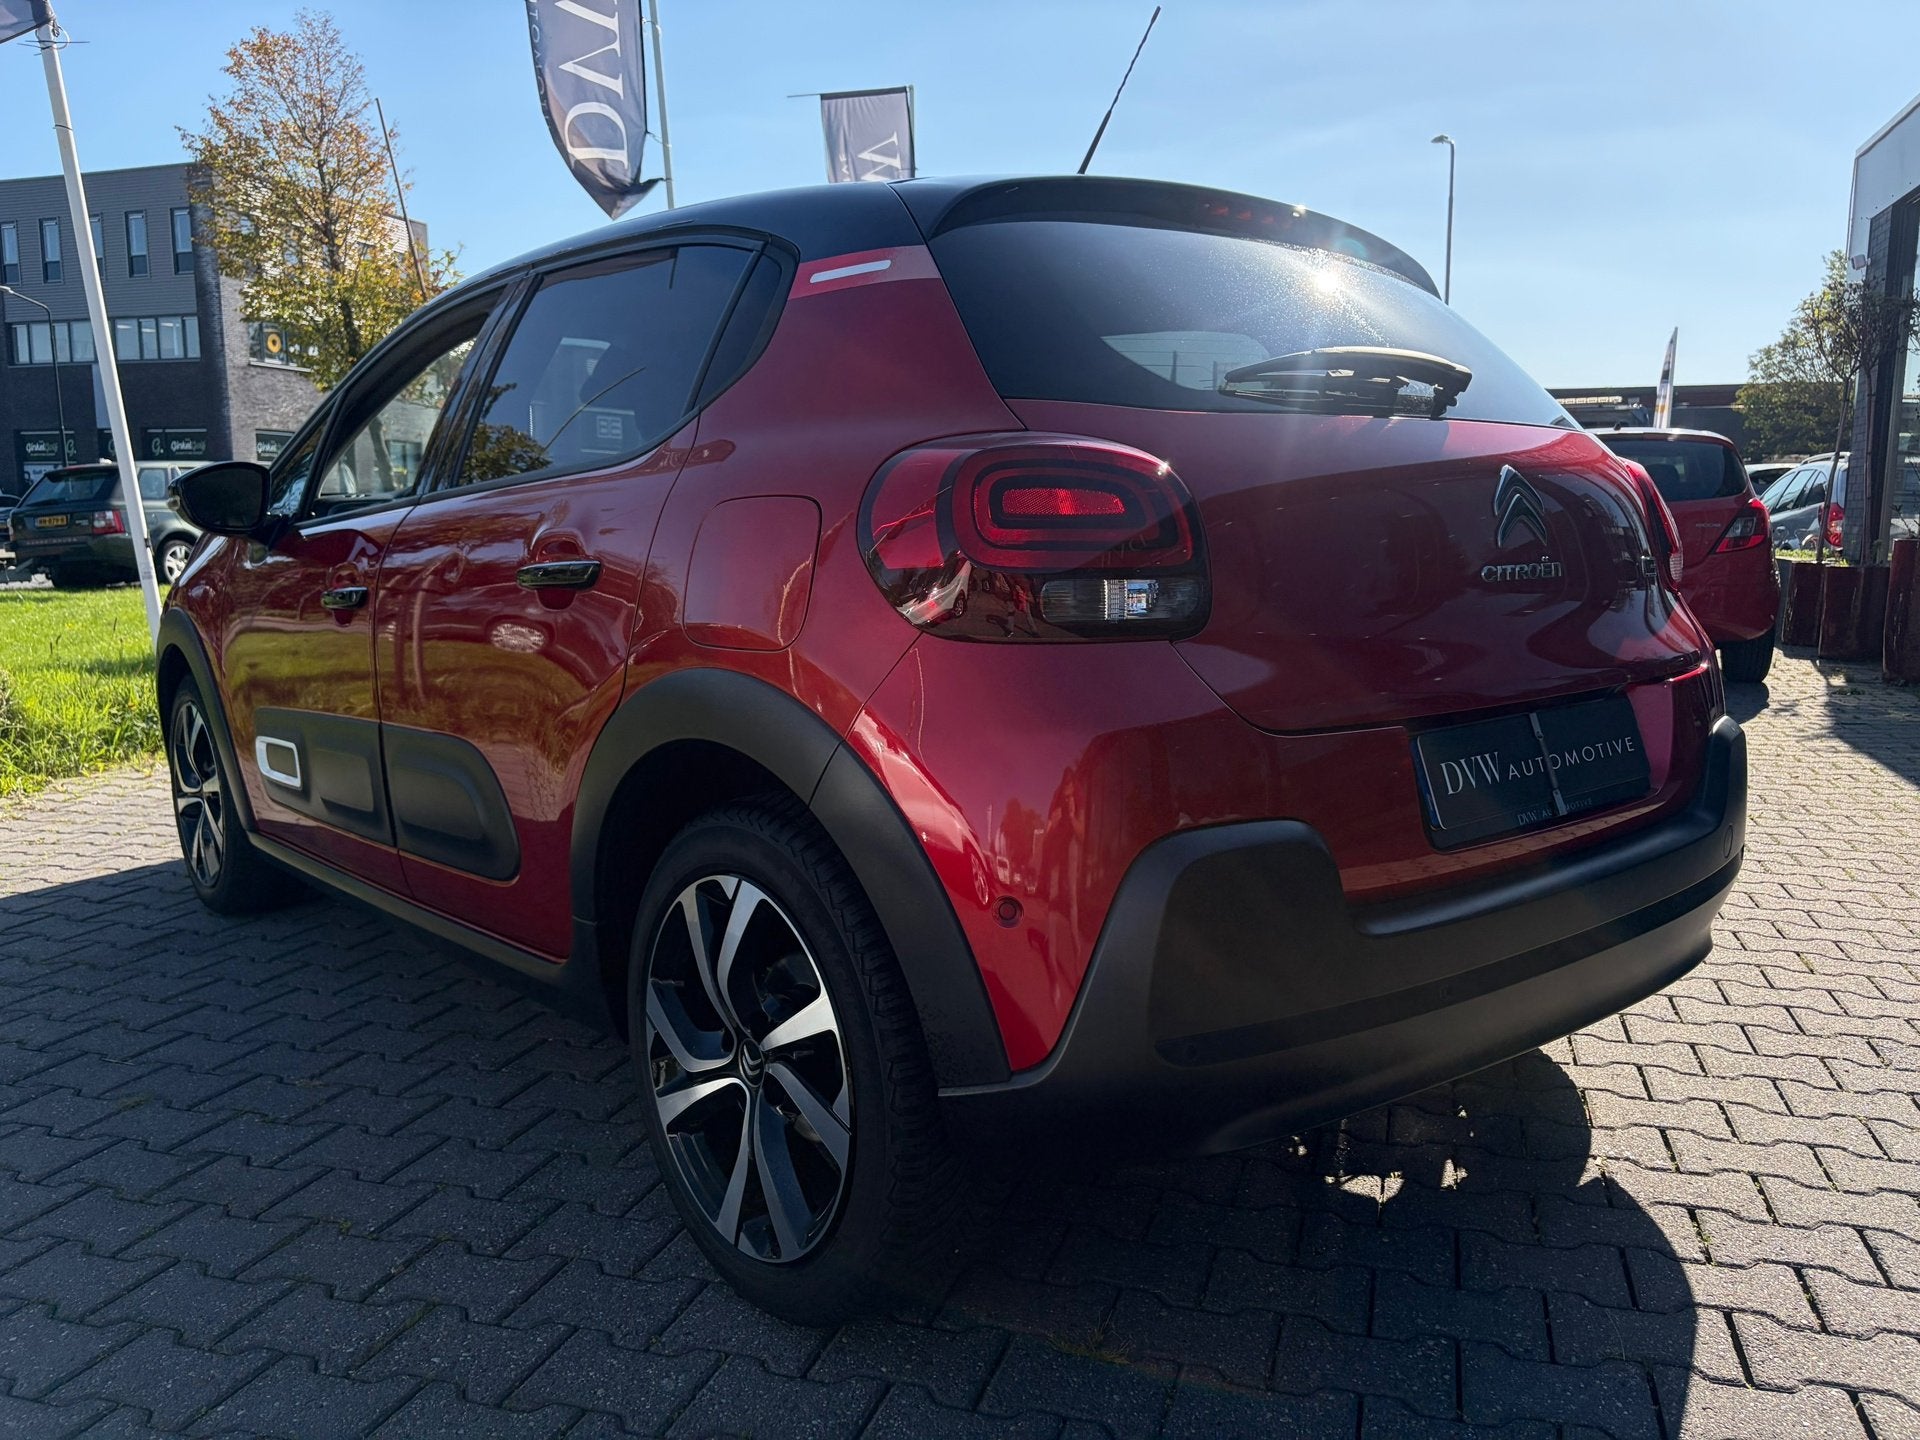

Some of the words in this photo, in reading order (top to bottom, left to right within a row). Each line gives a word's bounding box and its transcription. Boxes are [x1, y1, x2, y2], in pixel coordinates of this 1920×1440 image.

[1481, 556, 1562, 583] CITROËN
[1440, 751, 1502, 795] DVW
[1507, 736, 1635, 781] AUTOMOTIVE
[1542, 796, 1593, 818] AUOTIVE
